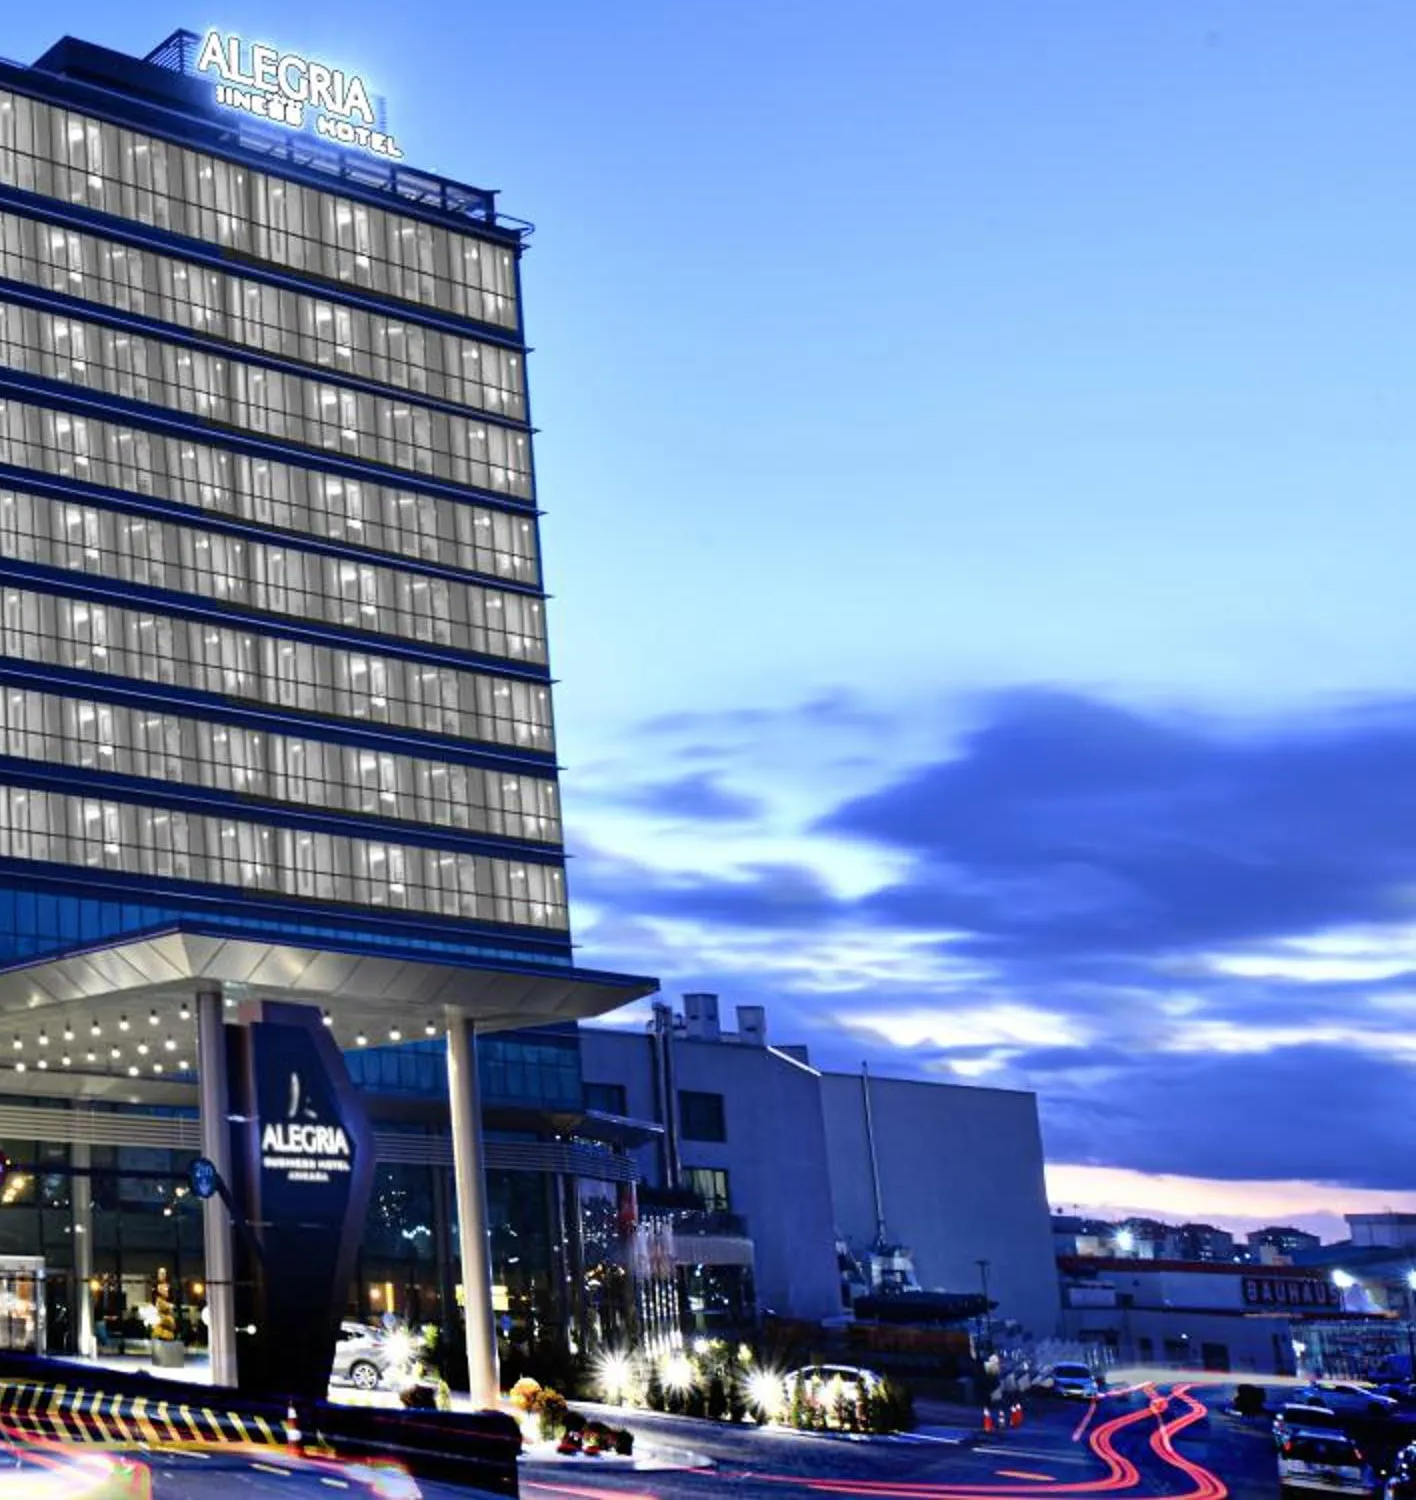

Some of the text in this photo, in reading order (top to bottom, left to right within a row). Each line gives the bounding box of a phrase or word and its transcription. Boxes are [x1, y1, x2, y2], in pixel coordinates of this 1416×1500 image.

[198, 31, 375, 125] ALEGRIA
[315, 113, 405, 159] HOTEL
[262, 1122, 350, 1156] ALEGRIA
[1246, 1279, 1341, 1306] BAUHAUS
